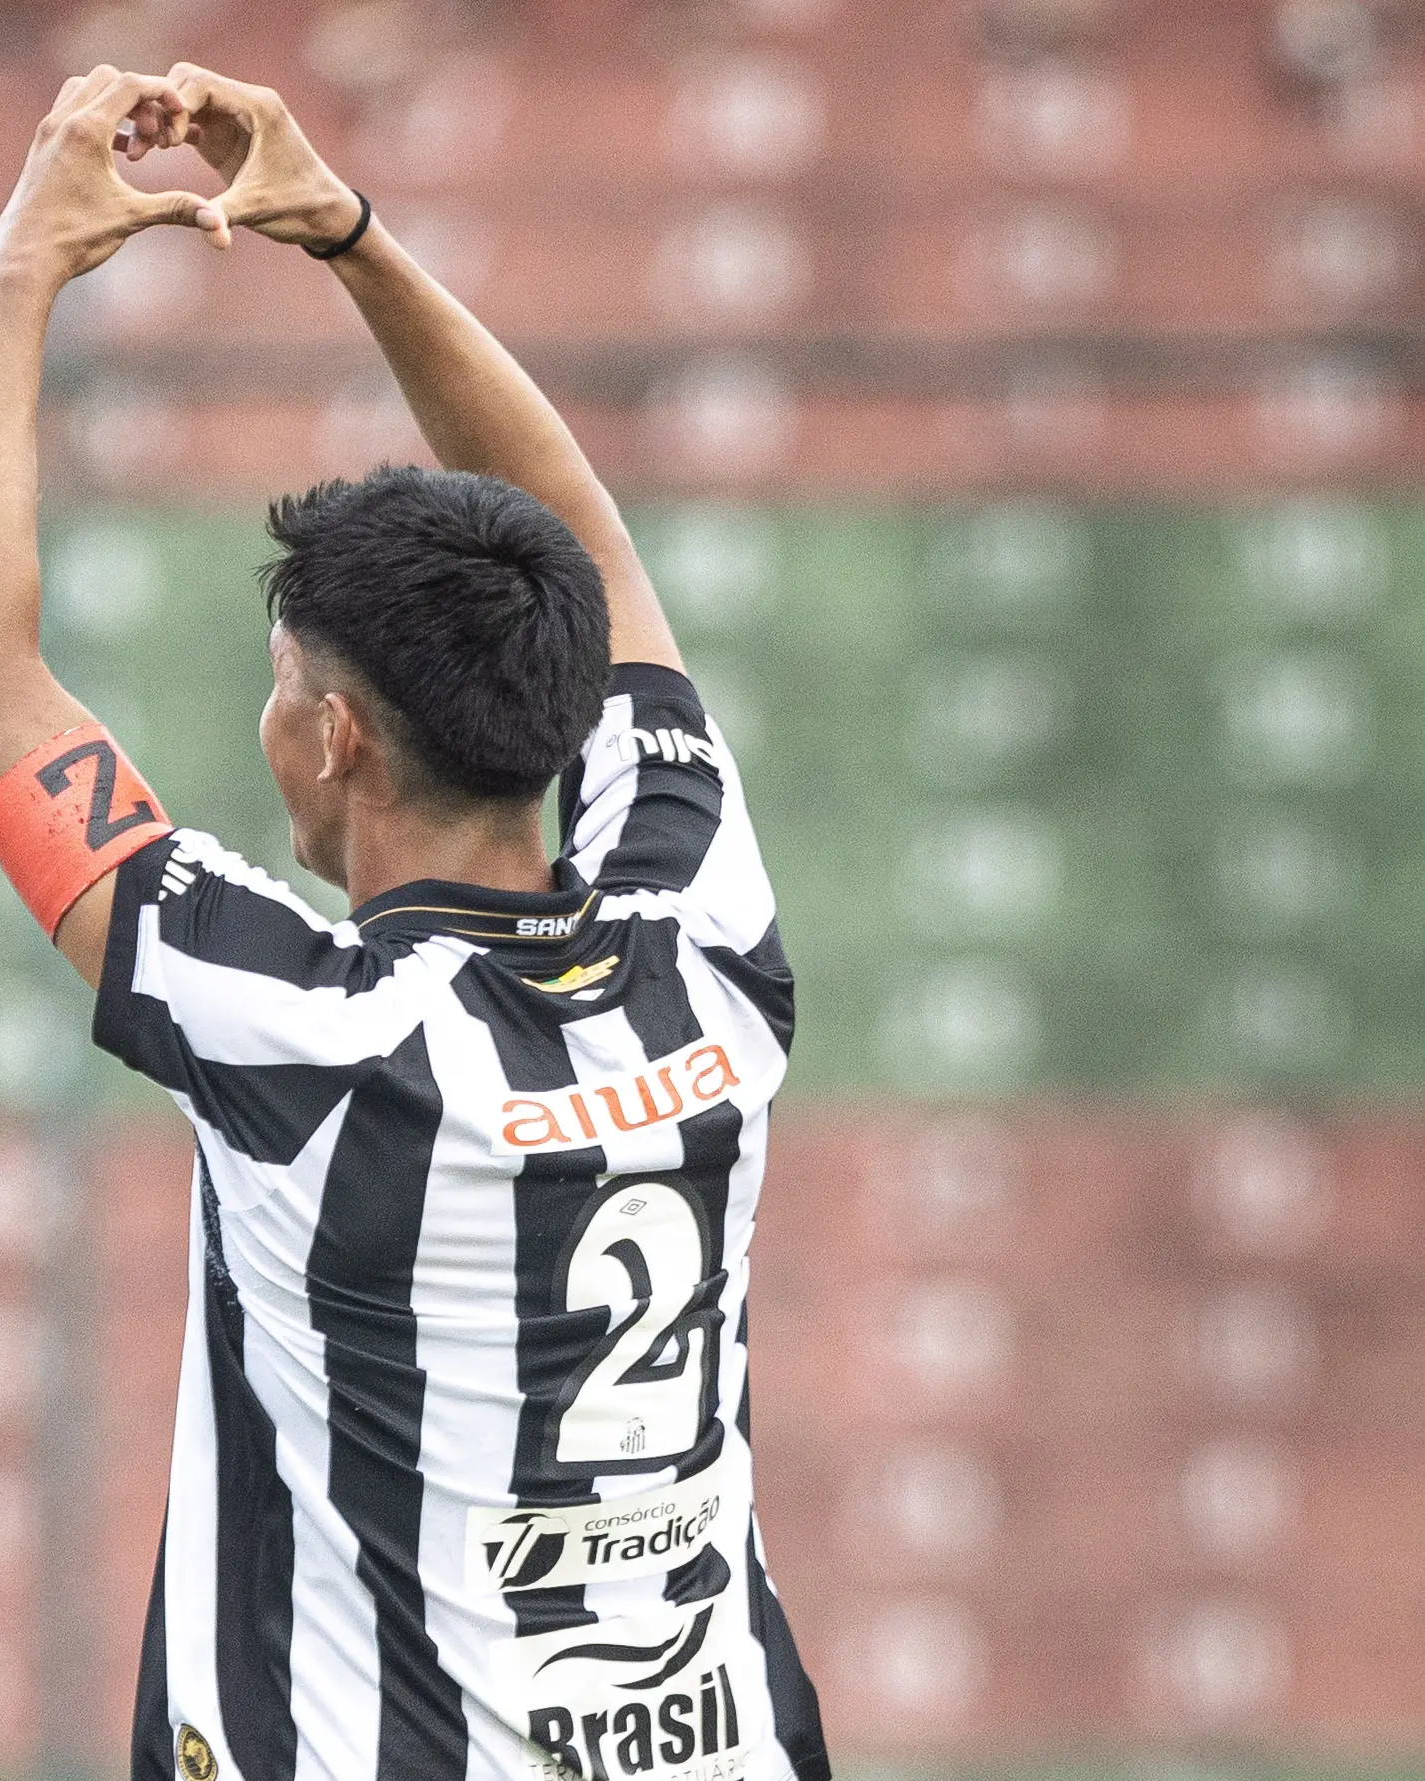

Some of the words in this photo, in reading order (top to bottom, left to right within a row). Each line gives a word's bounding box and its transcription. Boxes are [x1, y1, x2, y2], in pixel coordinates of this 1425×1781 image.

[501, 1044, 741, 1147] aiwa
[555, 1181, 705, 1463] 2
[581, 1494, 720, 1566] Tradição
[584, 1502, 676, 1532] consórcio
